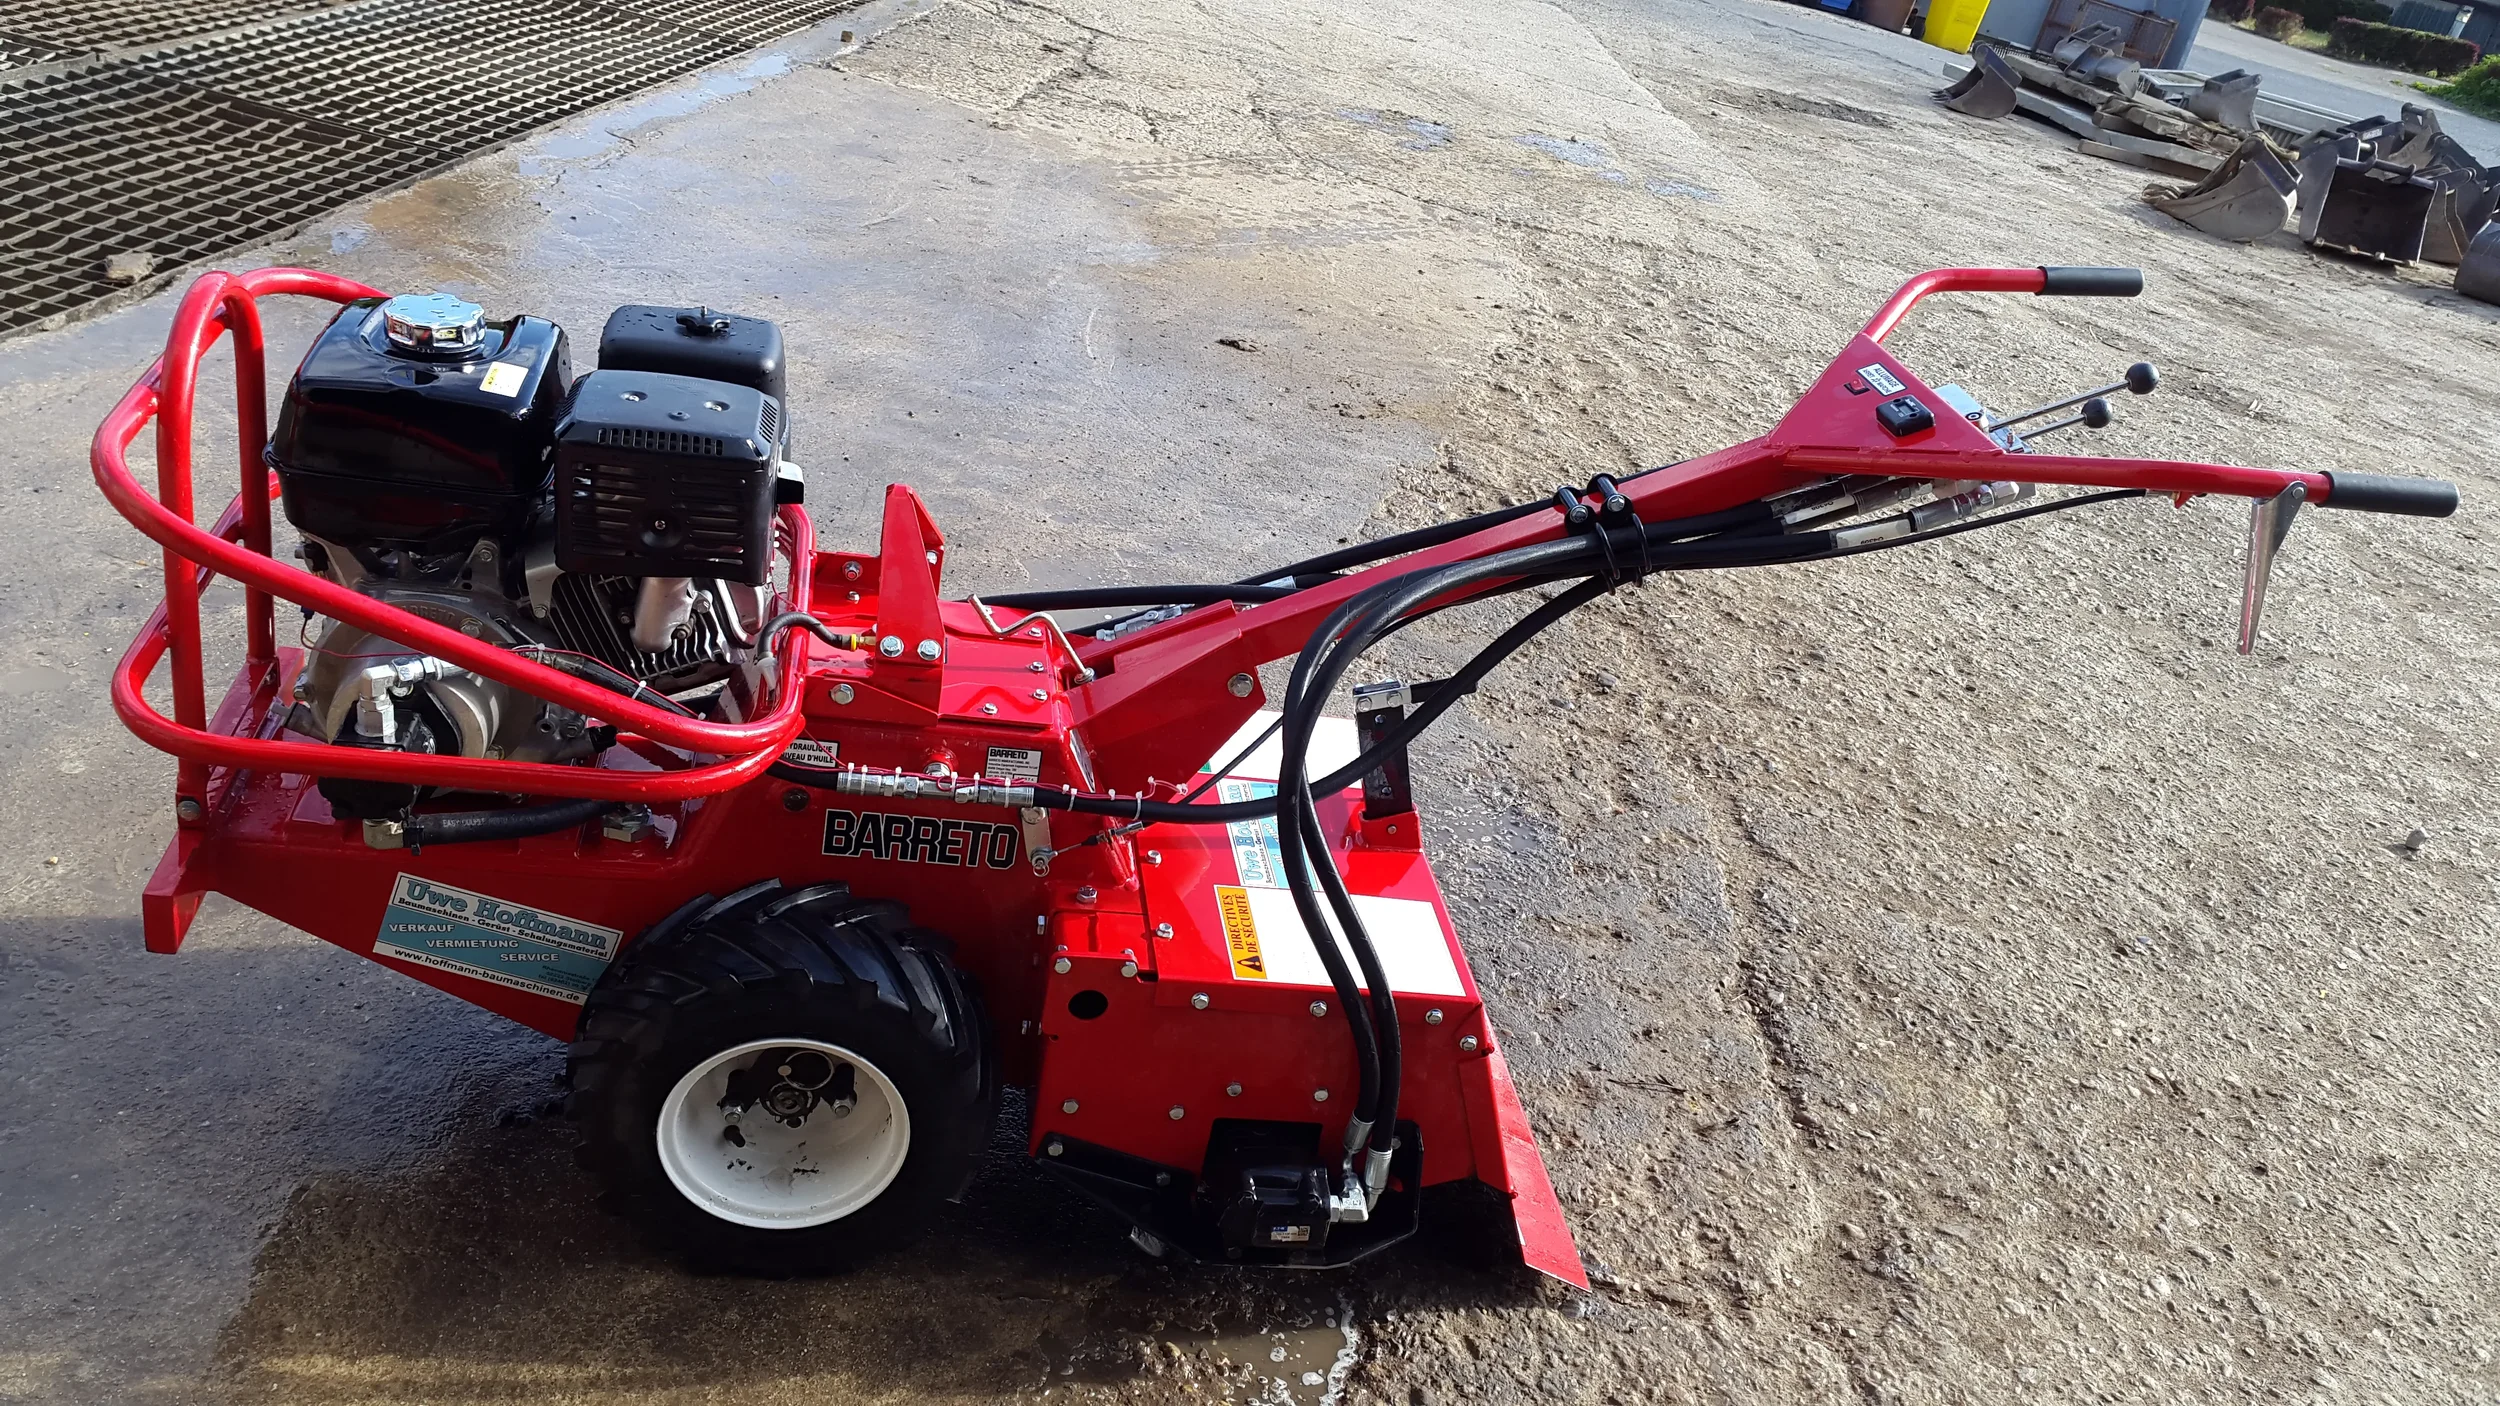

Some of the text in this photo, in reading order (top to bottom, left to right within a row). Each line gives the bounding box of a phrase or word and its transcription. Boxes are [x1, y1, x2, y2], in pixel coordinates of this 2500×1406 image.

[787, 742, 833, 753] YDRAULIQUE
[989, 748, 1028, 760] BARRETO
[822, 808, 1020, 870] BARRETO
[1243, 849, 1264, 881] Uwe
[388, 923, 456, 933] VERKAUF
[398, 897, 470, 922] Baumaschinen
[477, 918, 511, 933] Gerüst
[517, 929, 608, 958] Schalungsmaterial
[407, 880, 606, 950] Uwe Hoffmann
[1222, 894, 1244, 950] DIRECTIVES
[1233, 893, 1258, 953] DE SÉCURITÉ
[425, 939, 519, 949] VERMIETUNG
[500, 952, 560, 962] SERVICE
[394, 948, 580, 1001] www.hoffmann-baumaschinen.de
